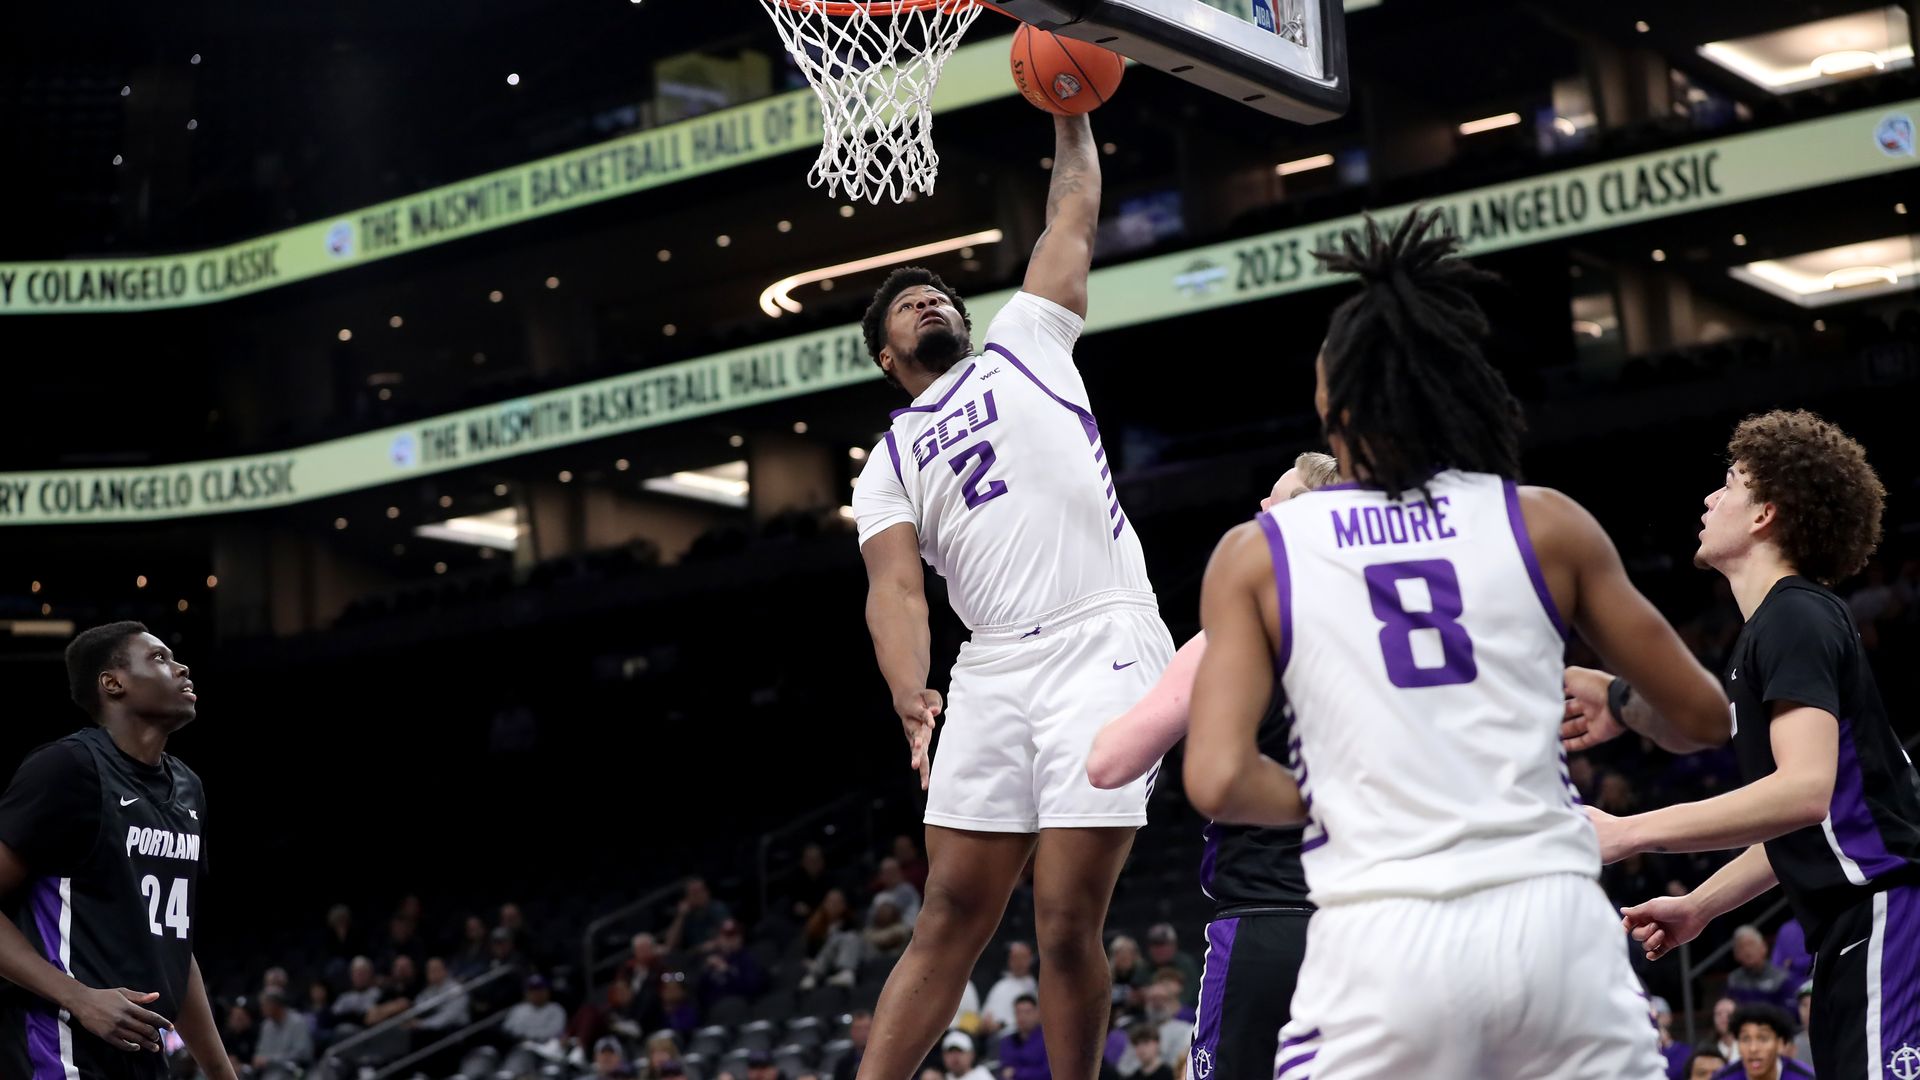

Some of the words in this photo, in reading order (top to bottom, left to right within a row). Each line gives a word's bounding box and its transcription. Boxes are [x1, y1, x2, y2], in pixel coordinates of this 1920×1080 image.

[1255, 5, 1272, 29] NBA
[361, 216, 399, 252] THE
[408, 173, 523, 238] NAISMITH
[529, 136, 682, 209] BASKETBALL
[691, 115, 755, 161] HALL
[763, 101, 801, 147] OF
[1235, 239, 1303, 291] 2023
[1414, 178, 1588, 250] OLANGELO
[1599, 149, 1722, 216] CLASSIC
[27, 264, 187, 304] COLANGELO
[196, 243, 281, 287] CLASSIC
[420, 423, 459, 461] THE
[466, 399, 572, 453] NAISMITH
[580, 365, 720, 430] BASKETBALL
[728, 347, 790, 394] HALL
[799, 342, 825, 381] OF
[834, 332, 872, 375] FA
[979, 366, 1001, 381] WAC
[912, 388, 999, 473] GCU
[40, 474, 193, 514] COLANGELO
[201, 460, 295, 506] CLASSIC
[947, 439, 1009, 512] 2
[1331, 495, 1458, 549] MOORE
[1363, 558, 1478, 689] 8
[141, 873, 191, 940] 24
